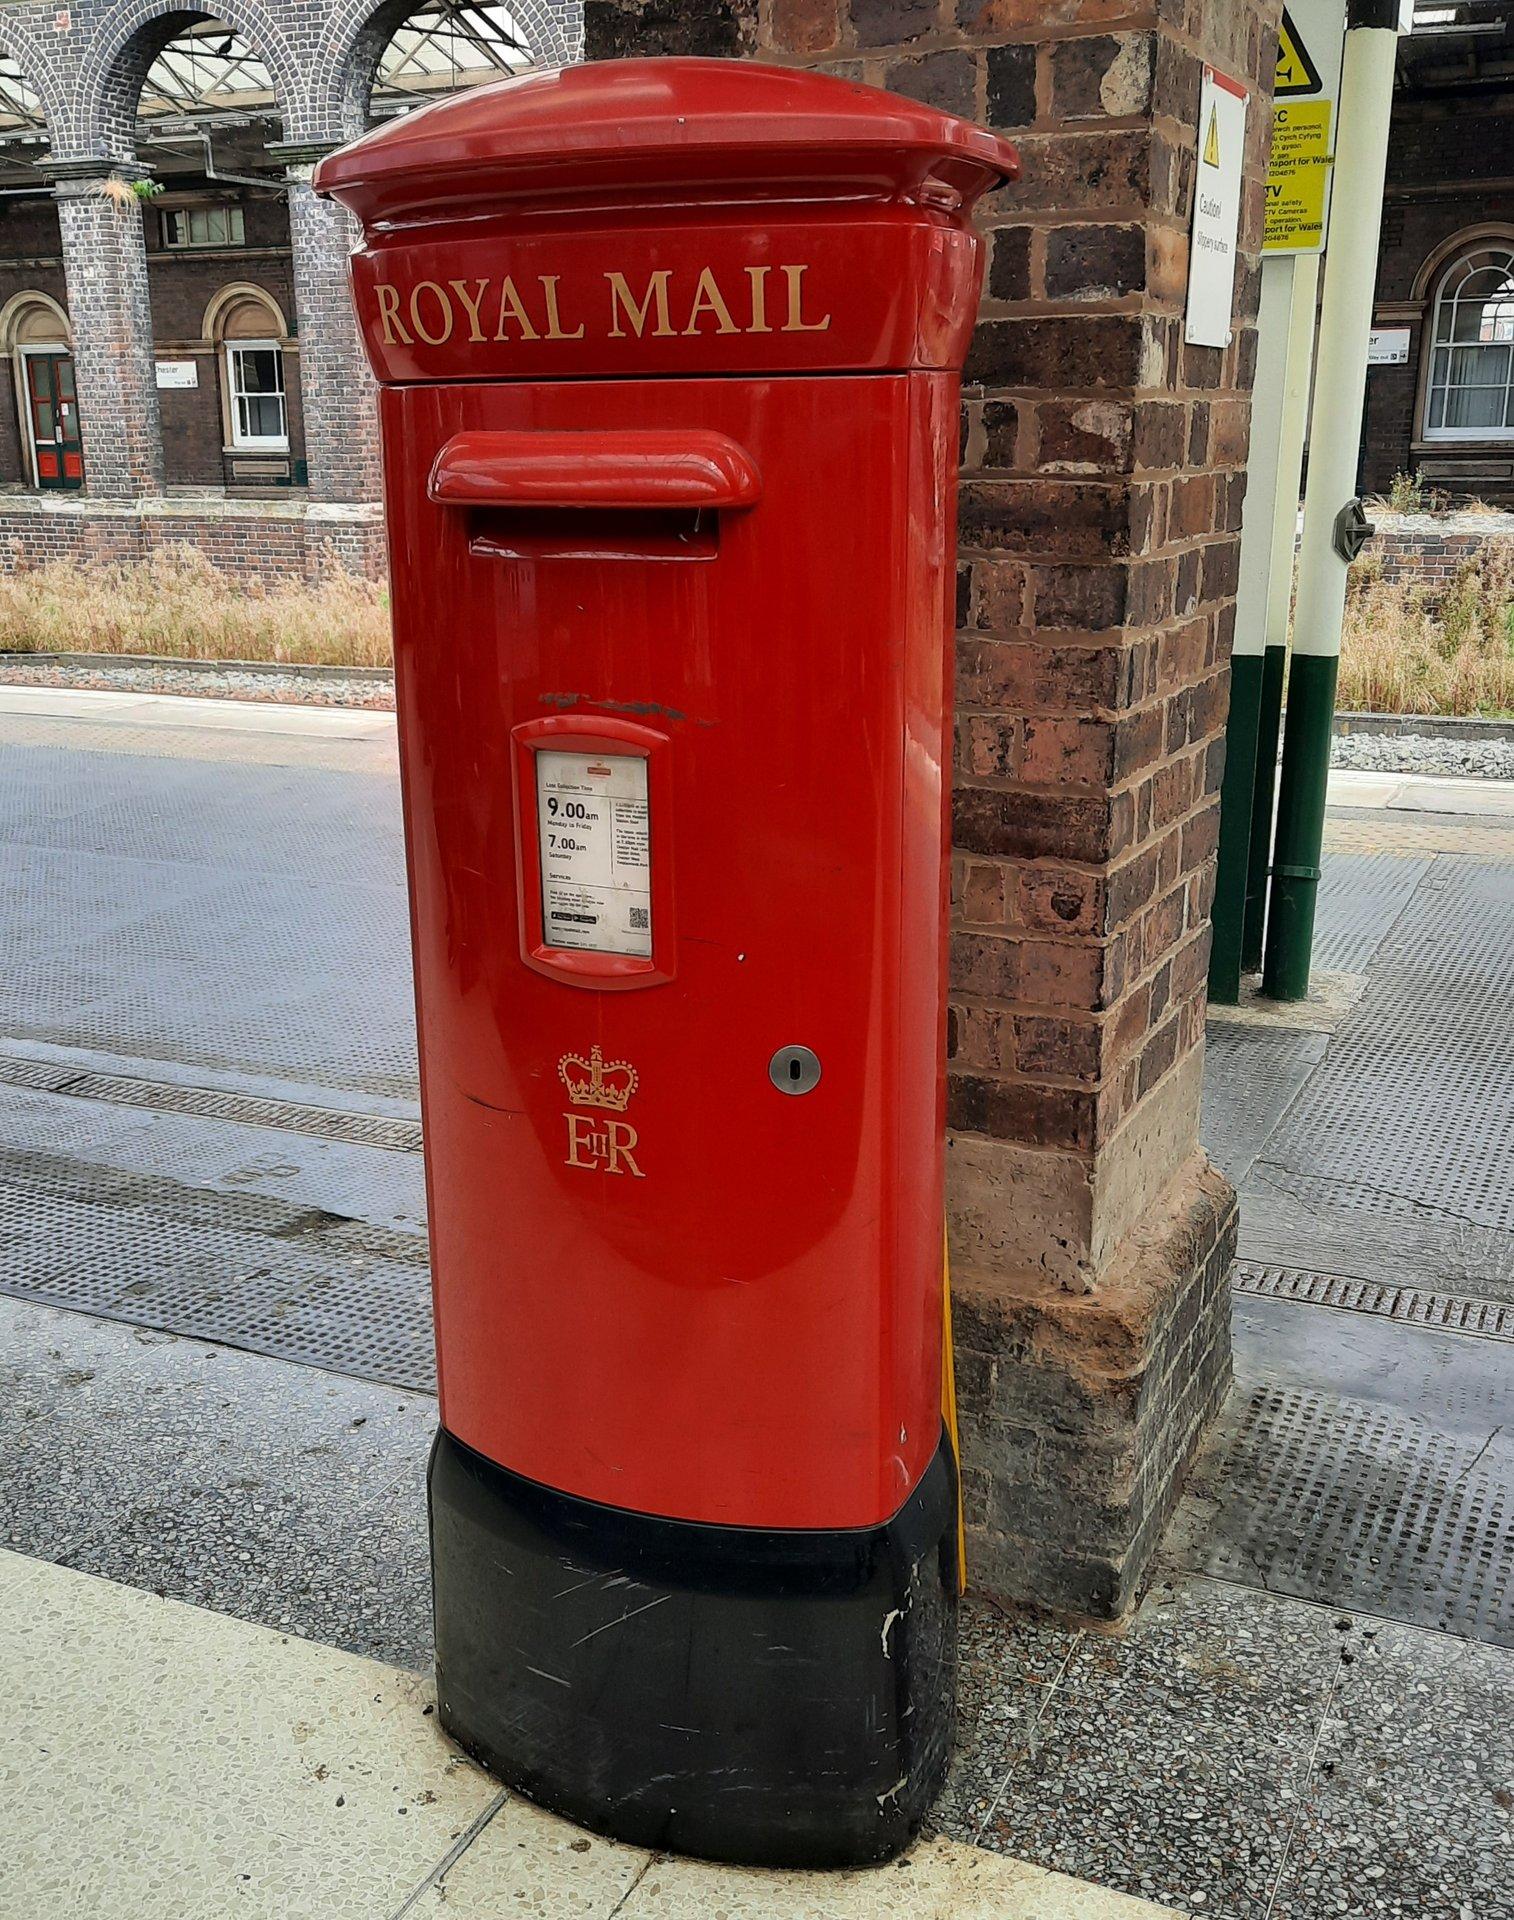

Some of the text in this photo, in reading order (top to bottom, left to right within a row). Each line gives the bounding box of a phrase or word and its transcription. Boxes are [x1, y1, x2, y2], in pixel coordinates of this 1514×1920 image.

[1274, 110, 1288, 122] C
[1298, 157, 1310, 165] for
[1200, 193, 1222, 219] Caution!
[1285, 223, 1297, 232] for
[373, 265, 831, 345] ROYAL MAIL
[548, 797, 599, 821] 9.00am
[548, 819, 568, 828] Monday
[576, 822, 592, 831] Friday
[548, 834, 587, 851] 7.00am
[549, 851, 572, 860] Saturday
[549, 872, 571, 880] Services
